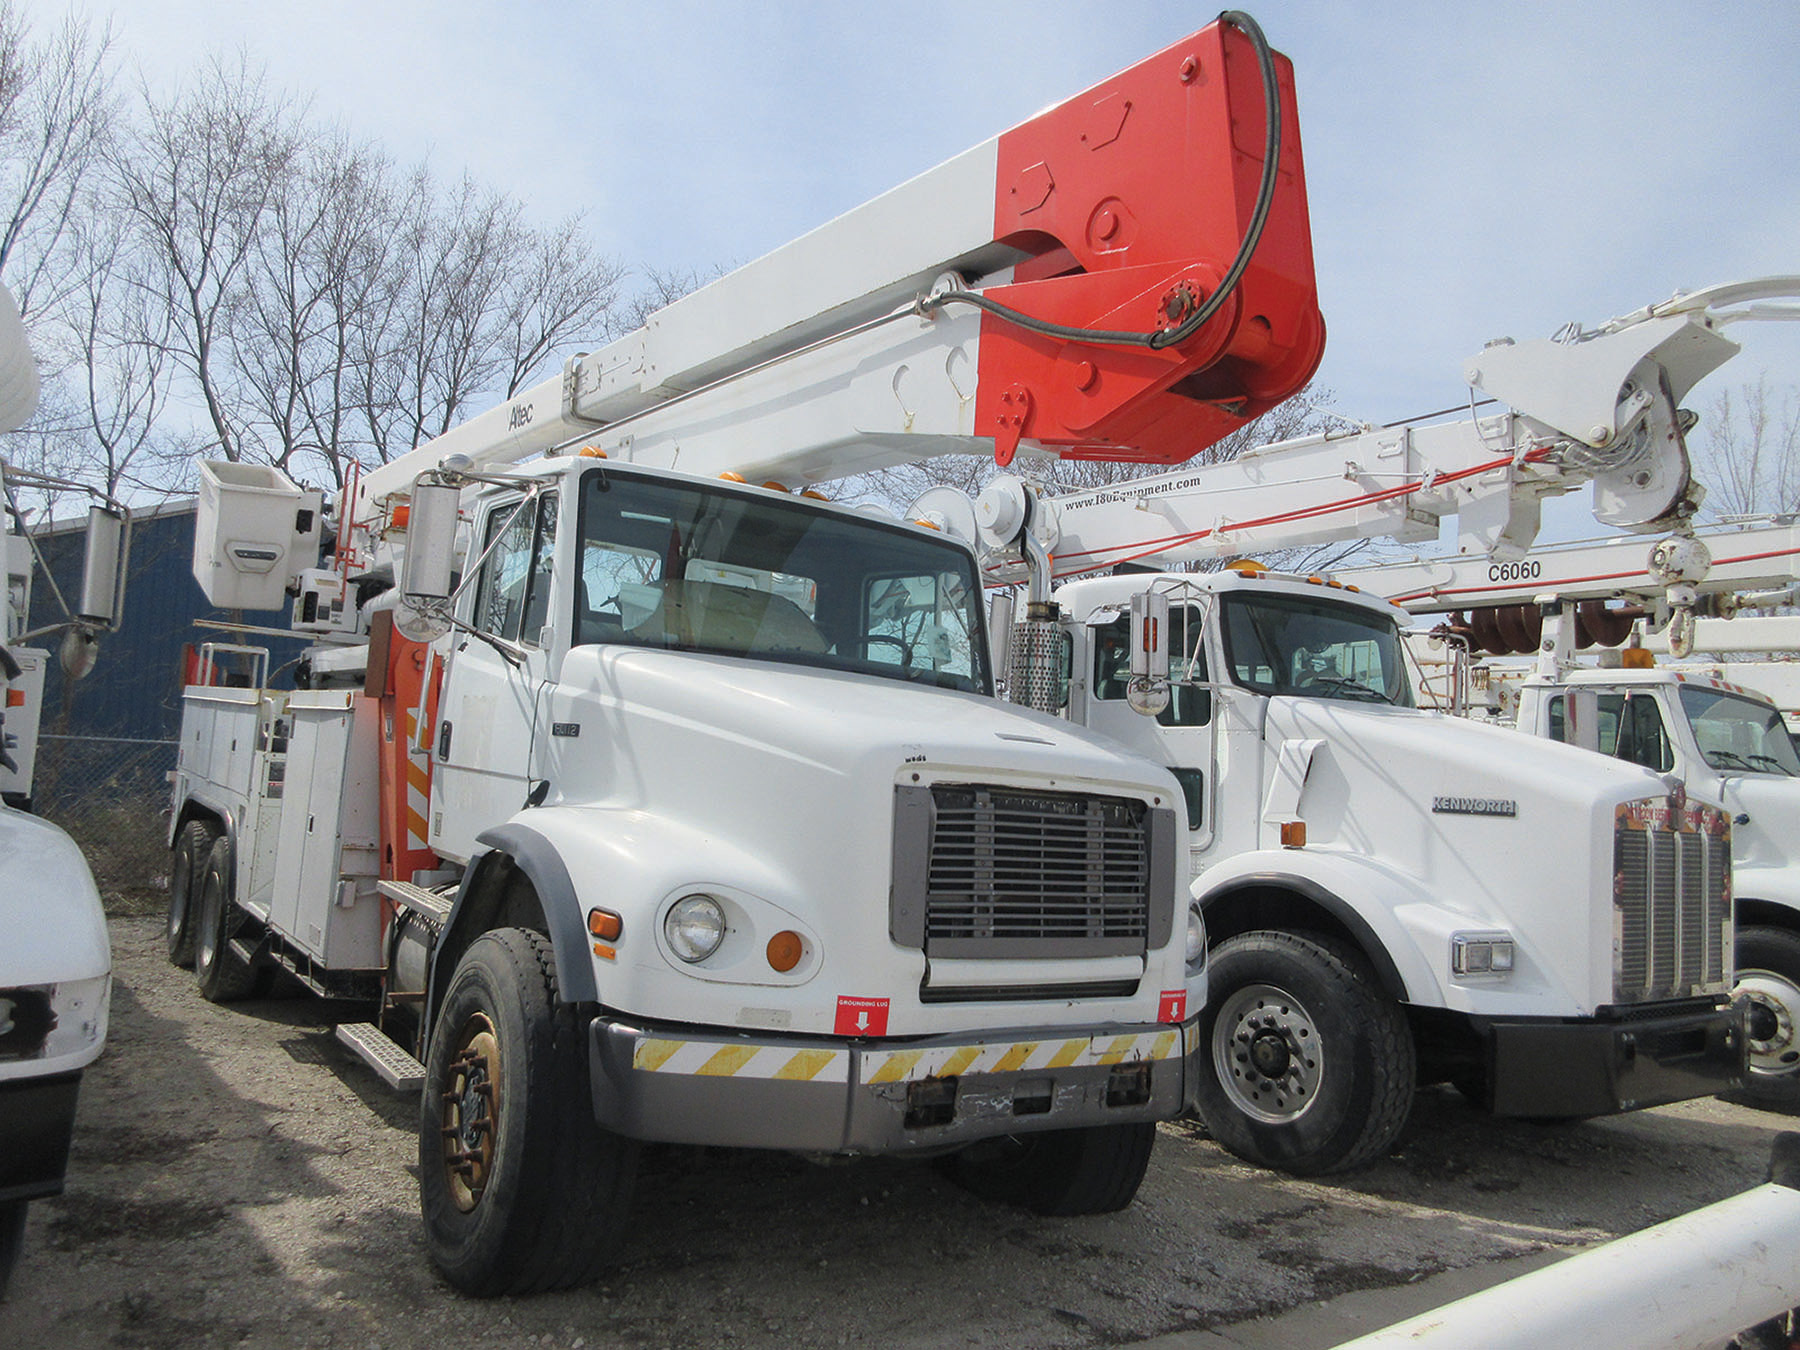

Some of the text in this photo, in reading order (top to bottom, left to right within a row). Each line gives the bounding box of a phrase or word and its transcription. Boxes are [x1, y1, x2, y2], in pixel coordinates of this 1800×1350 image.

[509, 403, 533, 431] Altec
[1488, 561, 1541, 582] C6060
[1432, 797, 1516, 816] KENWORTH
[838, 999, 876, 1007] GROUNDING
